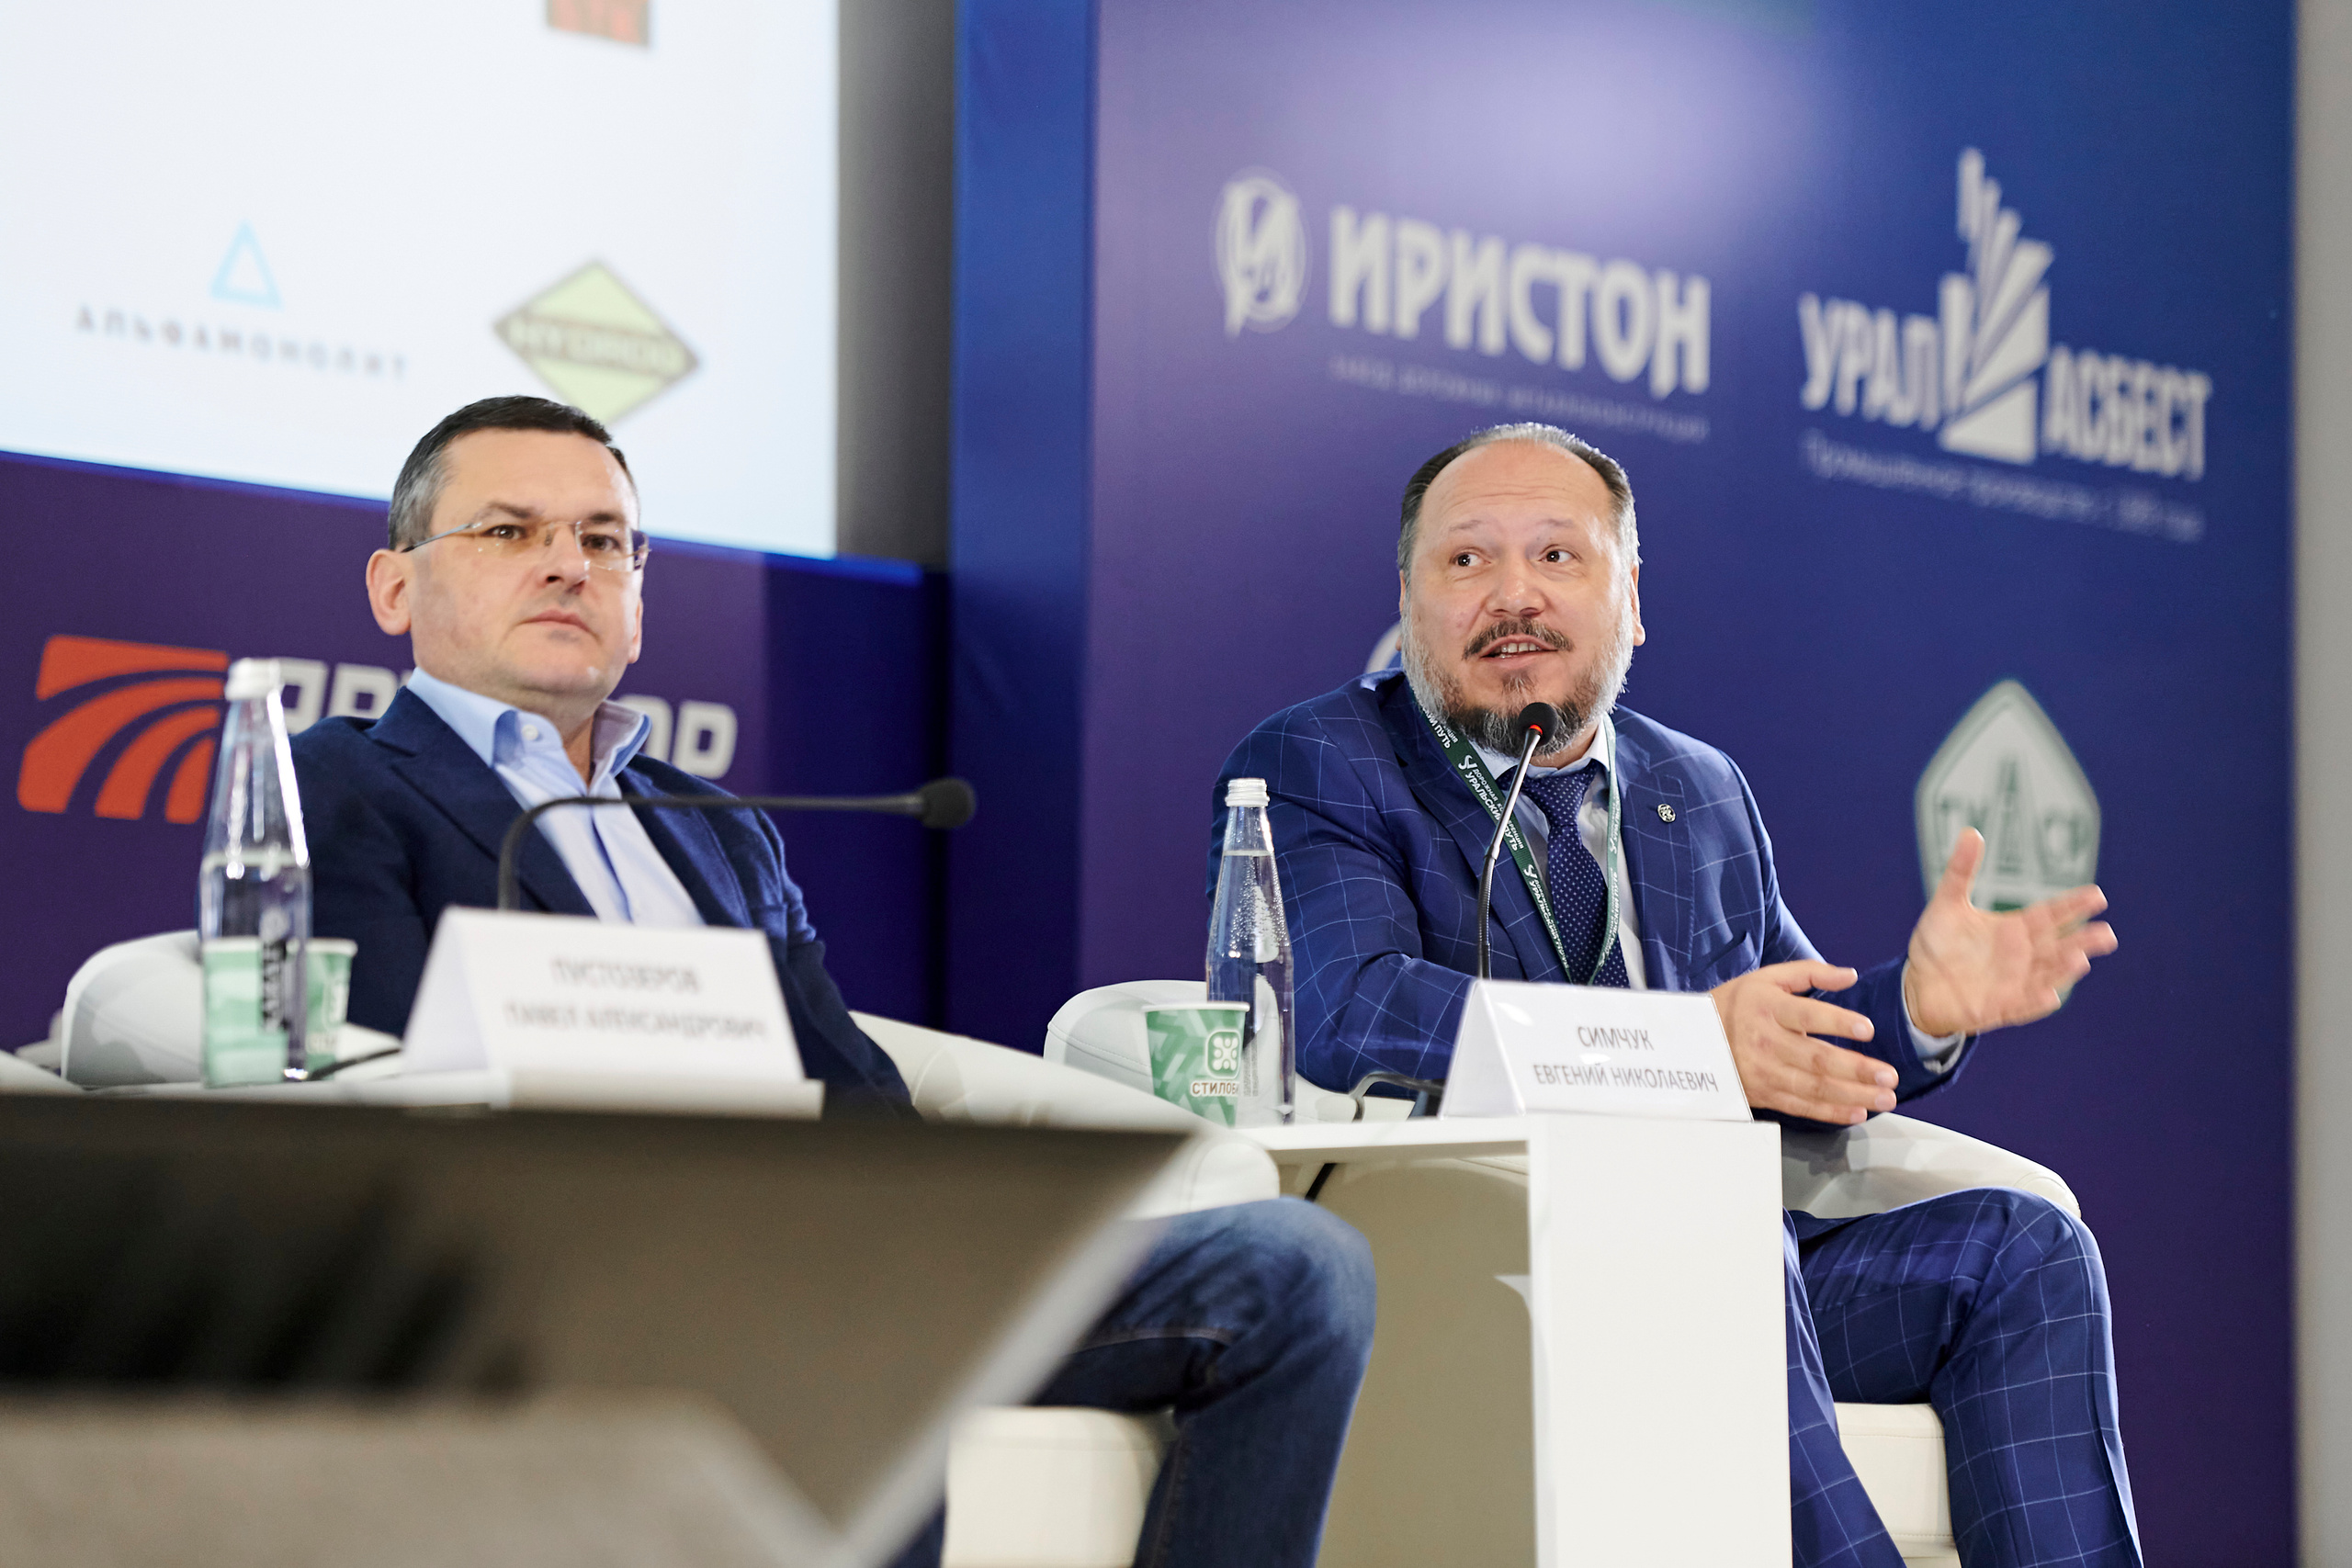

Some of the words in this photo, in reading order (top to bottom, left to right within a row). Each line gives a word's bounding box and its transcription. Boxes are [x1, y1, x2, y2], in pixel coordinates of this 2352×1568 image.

[1329, 204, 1710, 400] ИРИСТОН
[1799, 291, 1939, 432] УРАЛ
[2045, 344, 2211, 482] АСБЕСТ
[1473, 769, 1498, 802] ДОРОЖНАЯ
[1577, 1026, 1655, 1051] СИМЧУК
[1532, 1062, 1610, 1087] ЕВГЕНИЙ
[1611, 1066, 1720, 1093] НИКОЛАЕВИЧ
